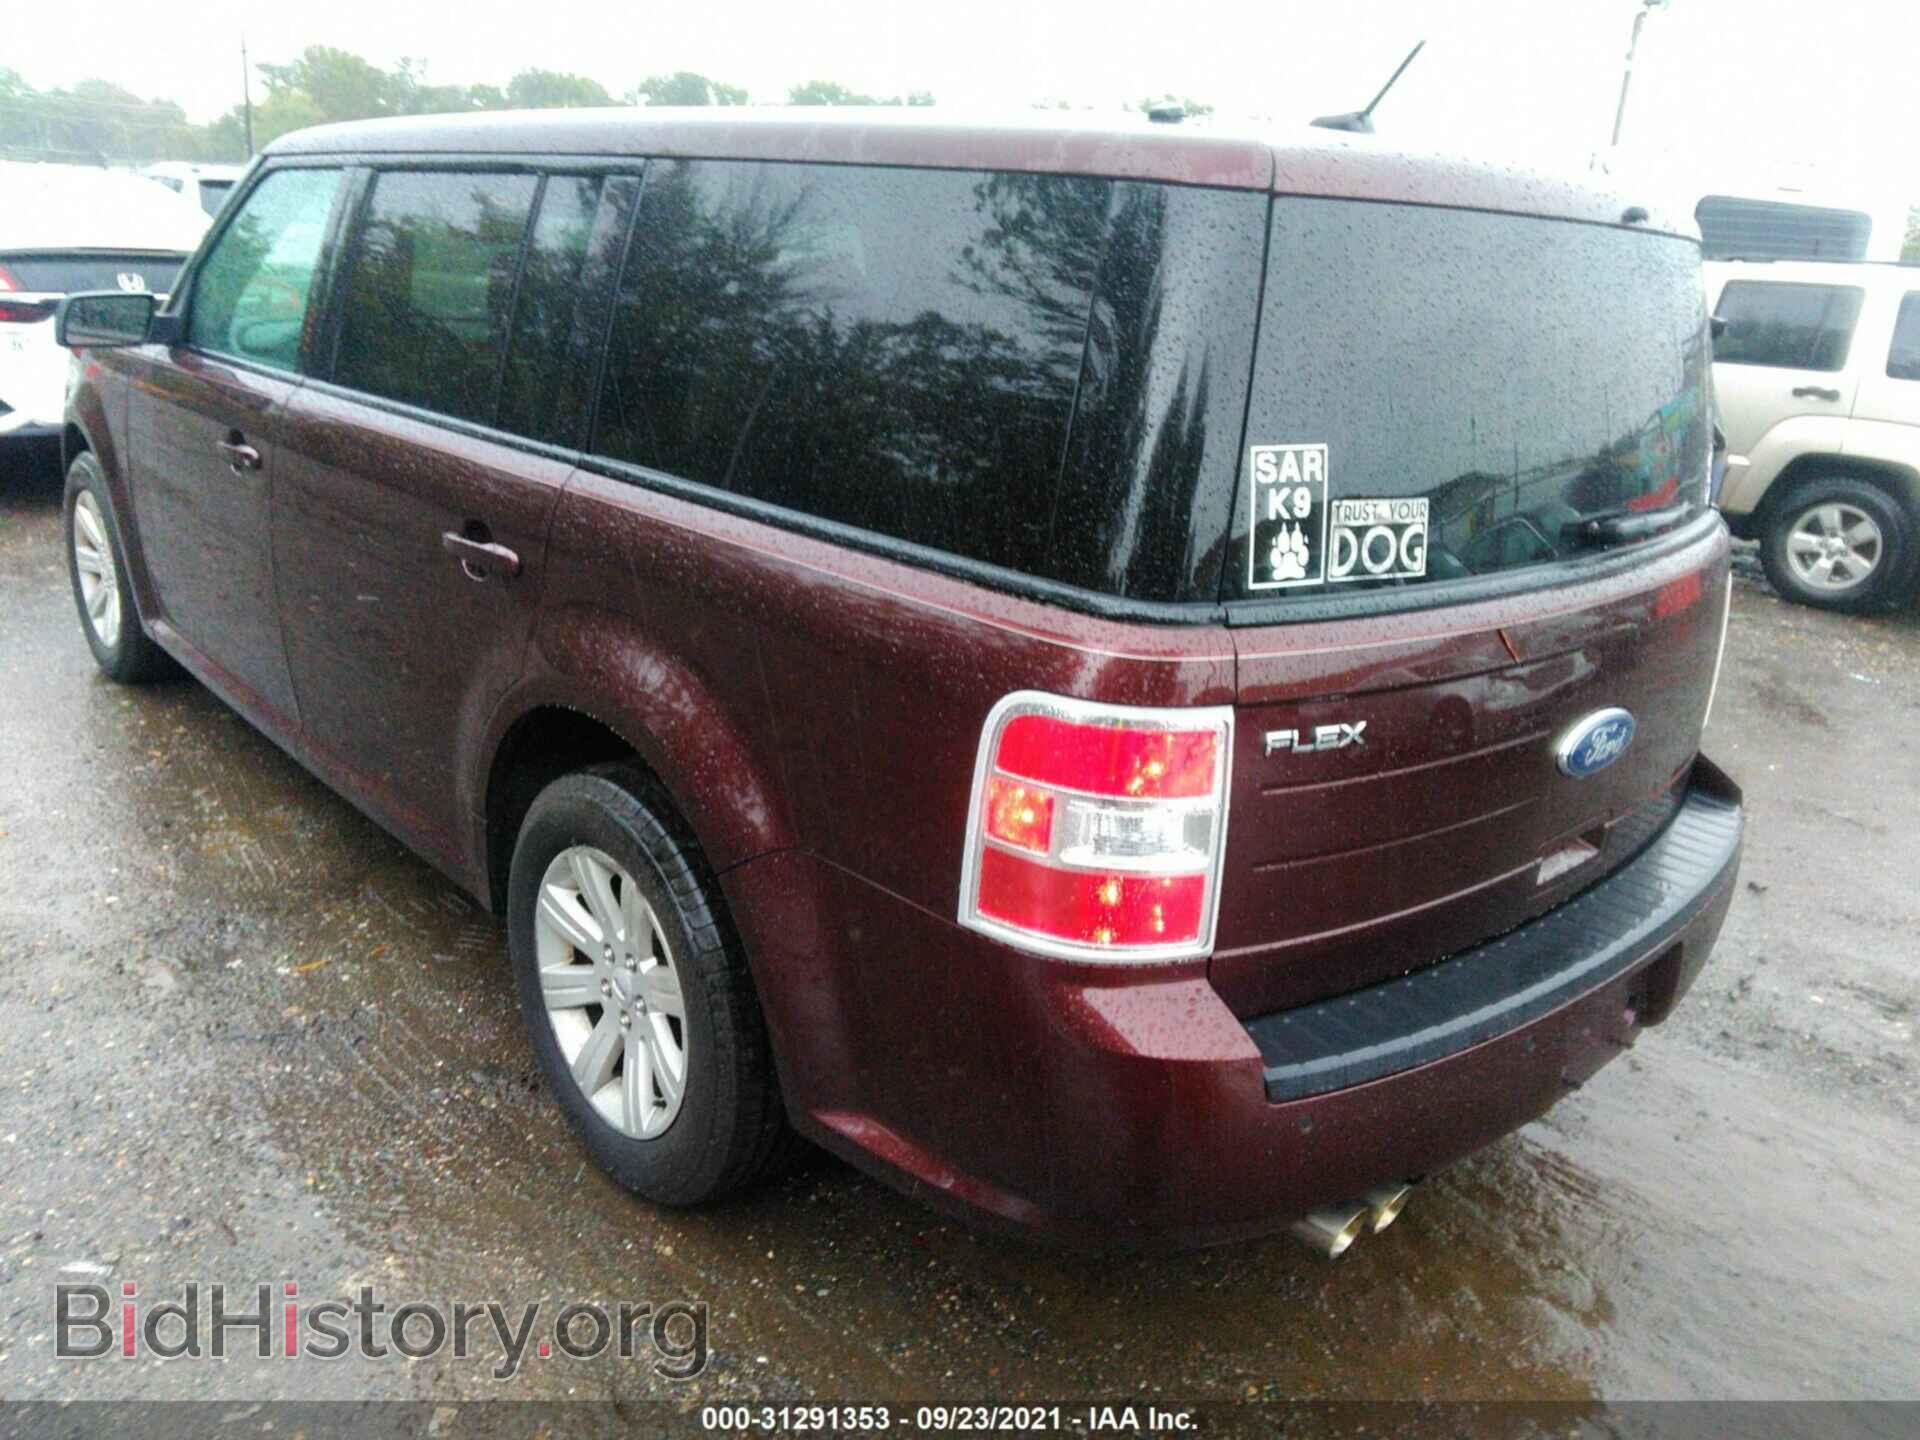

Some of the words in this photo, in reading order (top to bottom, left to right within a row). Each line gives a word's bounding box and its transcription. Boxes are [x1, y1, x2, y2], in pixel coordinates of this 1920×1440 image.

[1255, 449, 1324, 484] SAR
[1268, 486, 1312, 521] K9
[1333, 503, 1378, 522] TRUST
[1389, 502, 1427, 521] YOUR
[1330, 523, 1425, 578] DOG
[1264, 720, 1368, 758] FLEX
[1584, 722, 1627, 768] Ford
